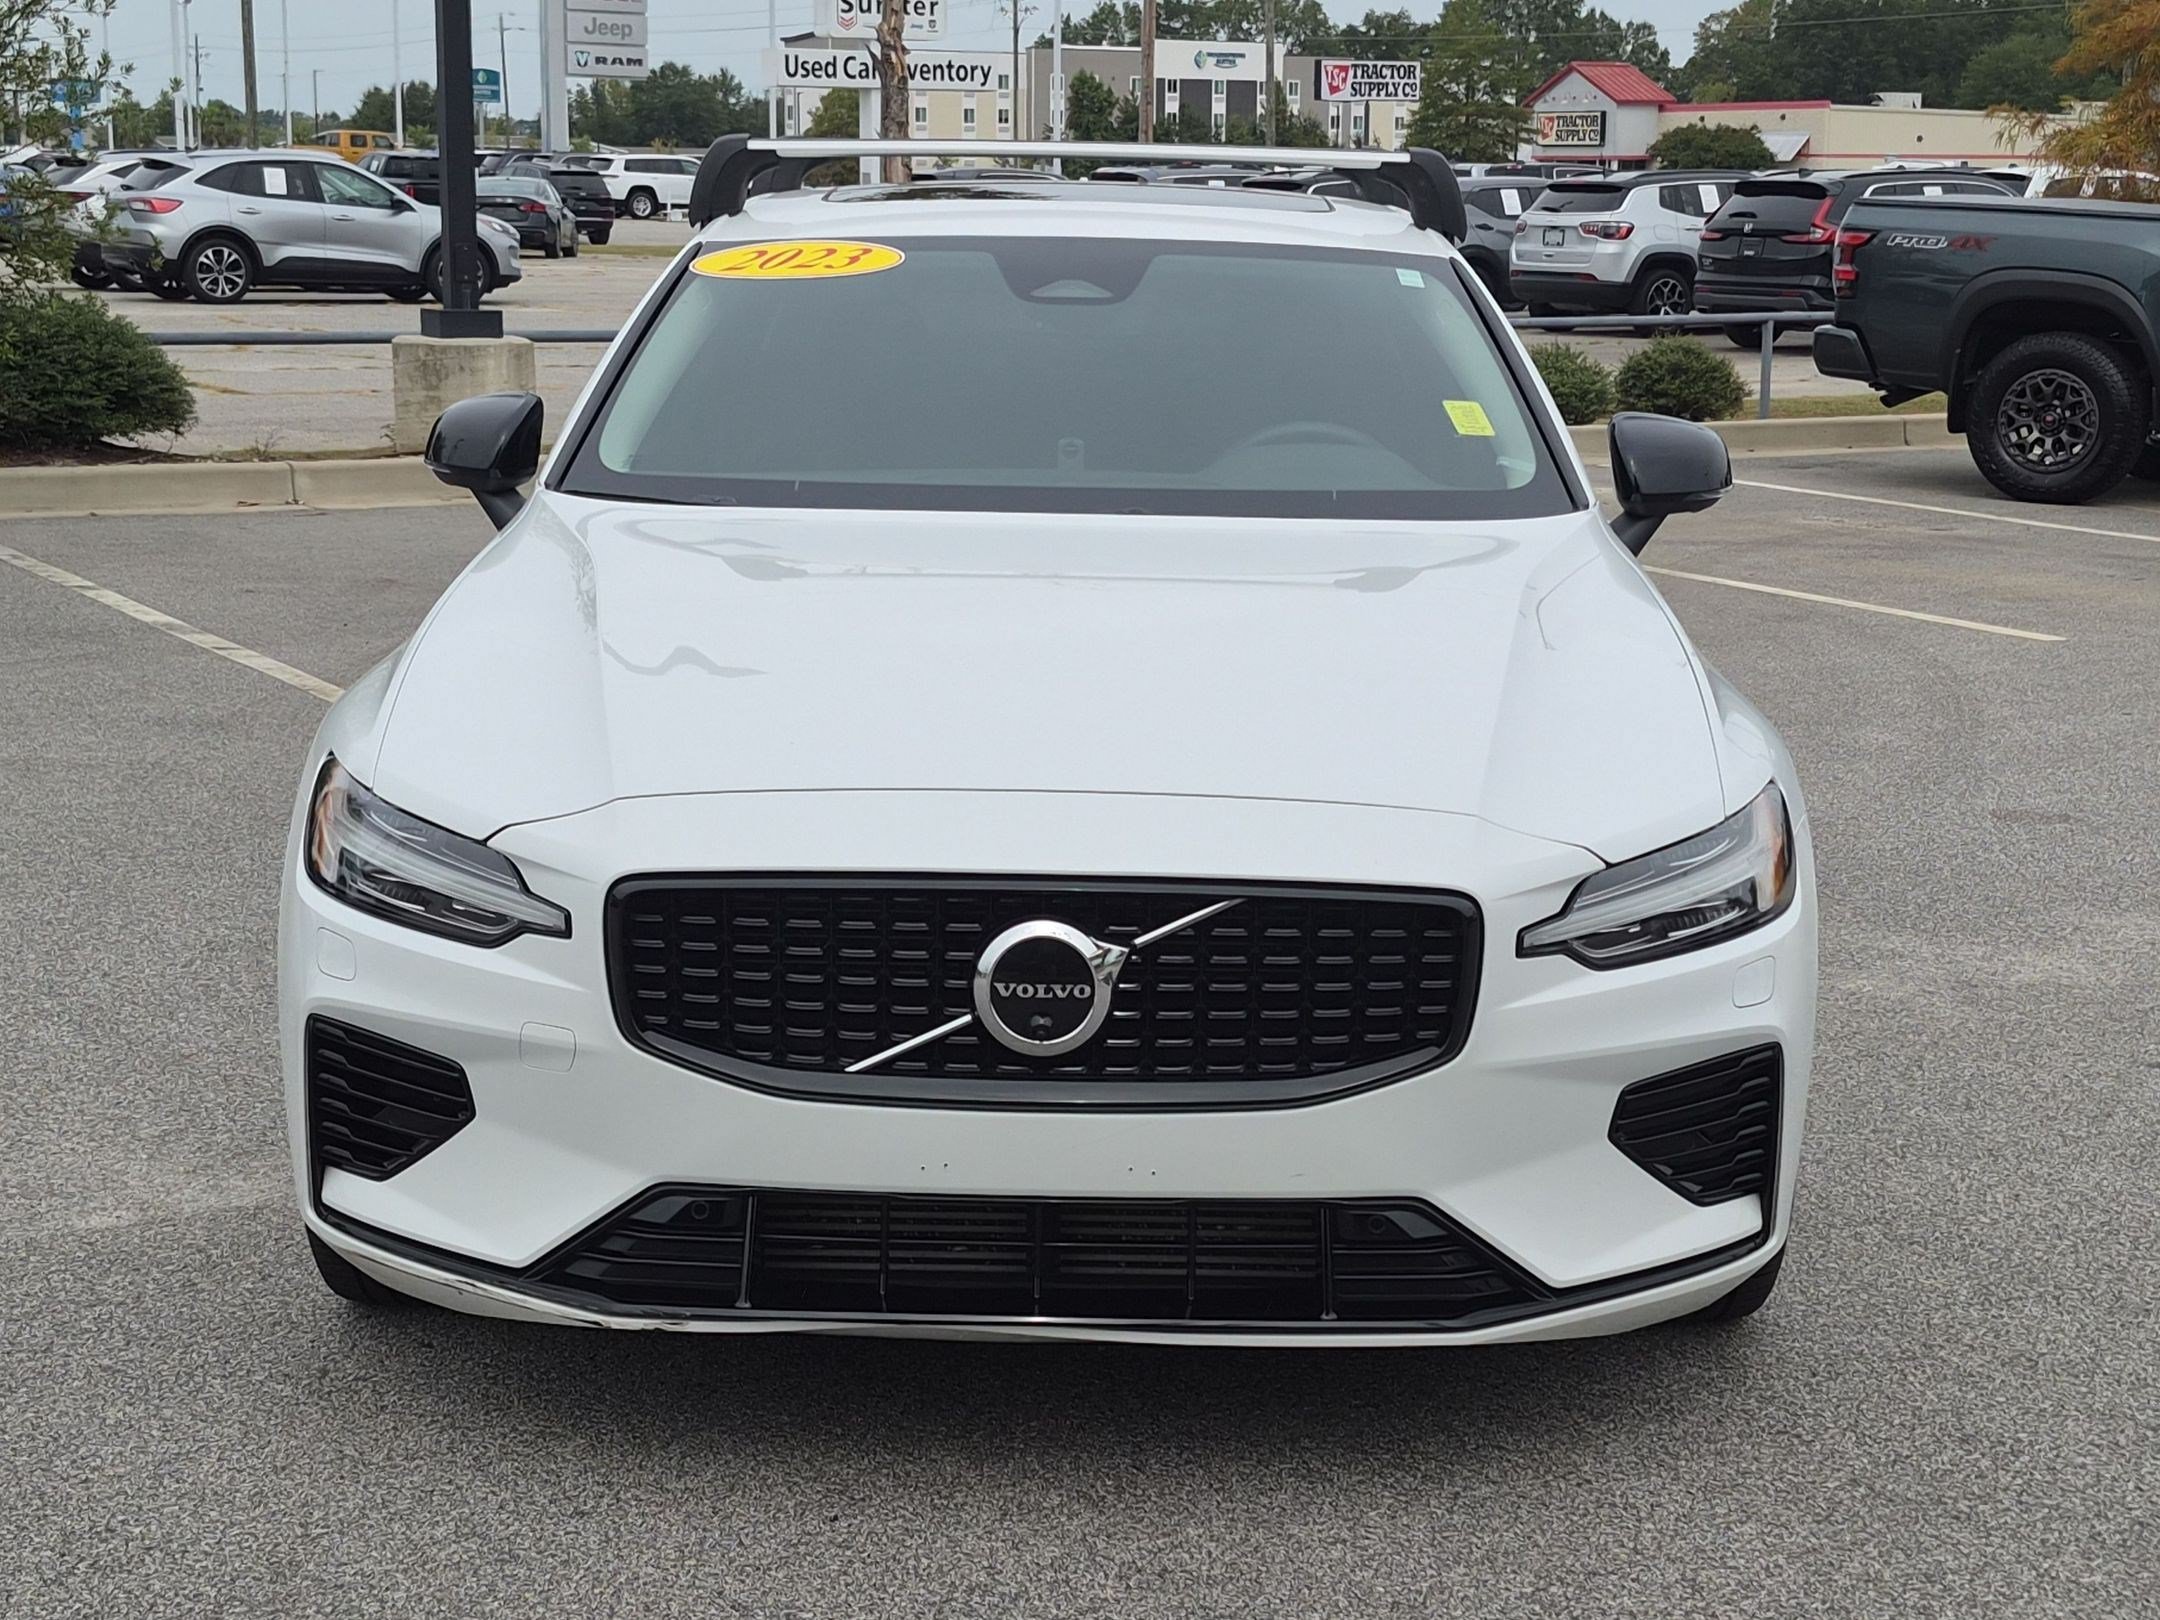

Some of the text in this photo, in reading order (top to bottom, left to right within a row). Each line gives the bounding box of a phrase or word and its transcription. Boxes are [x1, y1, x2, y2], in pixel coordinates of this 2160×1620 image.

[584, 17, 633, 40] Jeep
[594, 56, 643, 67] RAM
[784, 54, 992, 87] Used Car ventory
[1325, 65, 1346, 90] TSC
[1350, 64, 1417, 80] TRACTOR
[1350, 82, 1400, 97] SUPPLY
[1555, 115, 1599, 128] TRACTOR
[1555, 129, 1588, 142] SUPPLY
[719, 247, 873, 272] 2023
[993, 982, 1092, 999] VOLVO
